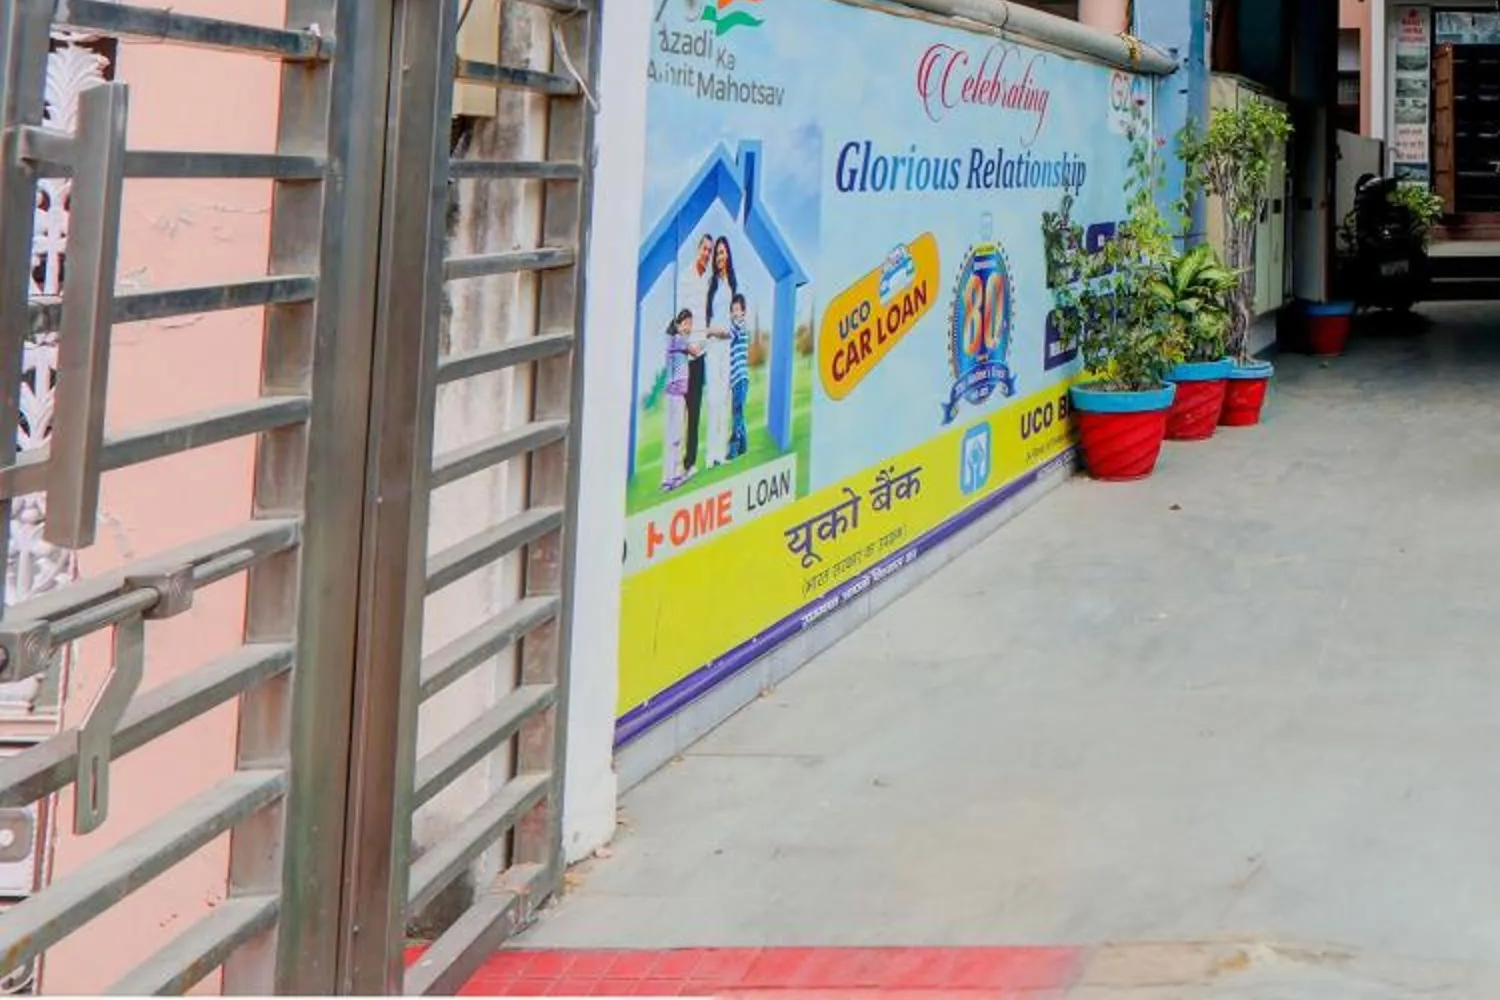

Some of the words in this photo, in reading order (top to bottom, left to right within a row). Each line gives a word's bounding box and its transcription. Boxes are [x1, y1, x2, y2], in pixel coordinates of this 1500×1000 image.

[696, 71, 785, 107] Mahotsav
[916, 42, 1049, 147] Celebrating
[835, 140, 963, 193] Glorious
[966, 147, 1088, 197] Relationship
[831, 327, 873, 383] CAR
[876, 280, 928, 346] LOAN
[838, 300, 872, 340] UCO
[1020, 401, 1052, 441] UCO
[746, 468, 792, 512] LOAN
[783, 486, 862, 569] यूको
[868, 465, 924, 512] बैंक
